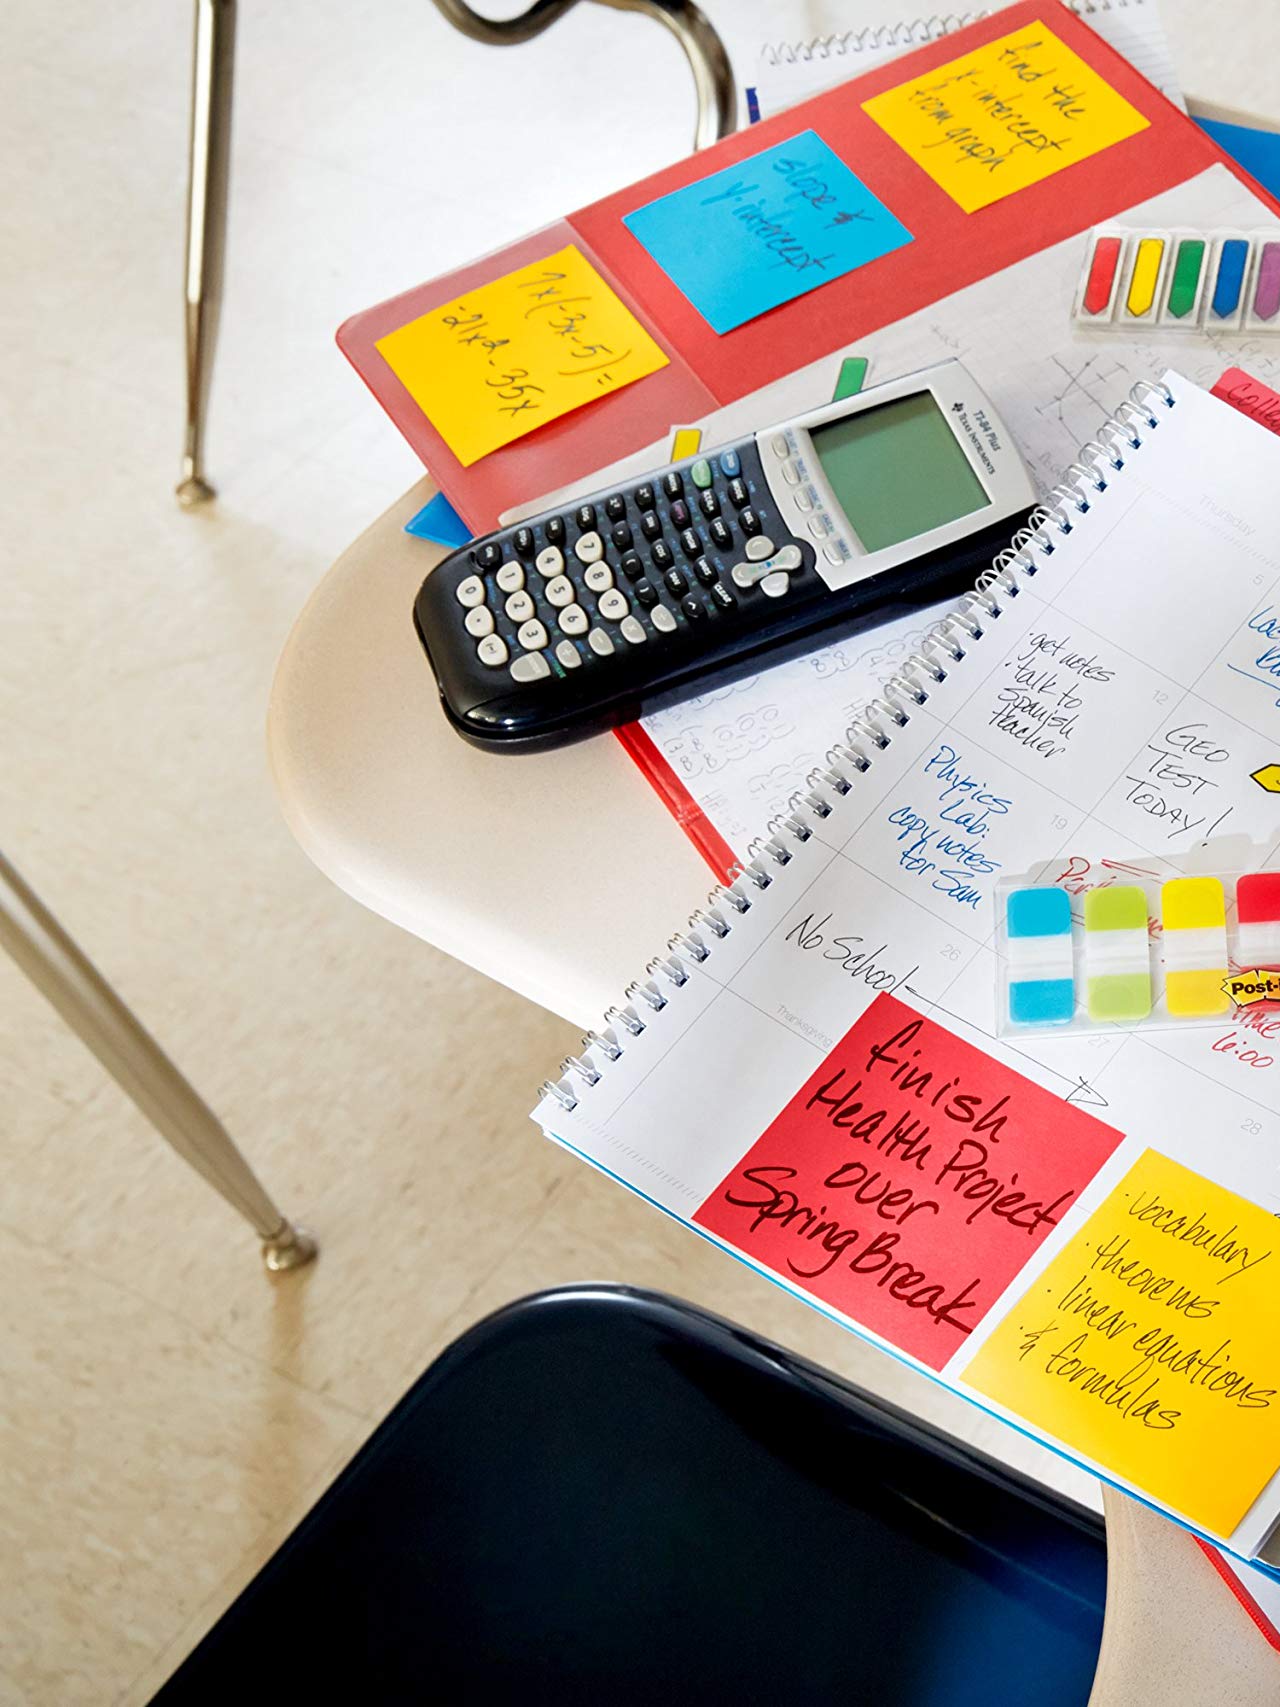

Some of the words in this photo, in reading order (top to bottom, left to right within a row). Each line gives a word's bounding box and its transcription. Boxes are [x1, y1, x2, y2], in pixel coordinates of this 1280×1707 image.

[908, 83, 954, 125] from
[998, 41, 1056, 82] find
[1043, 84, 1086, 120] the
[921, 127, 1014, 172] graph
[773, 158, 836, 210] slope
[986, 430, 1001, 451] Plus
[1200, 495, 1256, 537] Thursday
[713, 583, 732, 605] CLEAR
[1252, 574, 1264, 586] 5
[1013, 657, 1058, 696] talk
[1056, 683, 1083, 710] to
[1059, 655, 1116, 683] notes
[998, 687, 1079, 741] Spanish
[1152, 689, 1168, 705] 12
[988, 702, 1066, 758] teacher
[1165, 724, 1230, 763] GEO
[924, 745, 1013, 815] Physics
[1147, 744, 1220, 795] TEST
[940, 799, 990, 839] Lab:
[1051, 815, 1069, 831] 19
[1125, 775, 1234, 847] TODAY!
[888, 806, 939, 849] copy
[936, 835, 1001, 874] notes
[898, 841, 936, 876] for
[932, 869, 982, 910] Sam
[785, 913, 832, 951] No
[939, 943, 961, 961] 26
[776, 1004, 833, 1048] Thanksgiving
[1212, 1032, 1274, 1068] 6:00
[866, 1018, 1011, 1143] finish
[806, 1069, 929, 1171] Health
[935, 1141, 1075, 1235] Project
[1241, 1119, 1262, 1135] 28
[824, 1162, 939, 1226] over
[725, 1166, 859, 1279] Spring
[849, 1231, 981, 1333] Break
[1128, 1191, 1272, 1284] vocabulary
[1091, 1235, 1220, 1319] theorems
[1058, 1276, 1137, 1340] linear
[1121, 1329, 1278, 1409] equations
[1045, 1334, 1181, 1431] formulas
